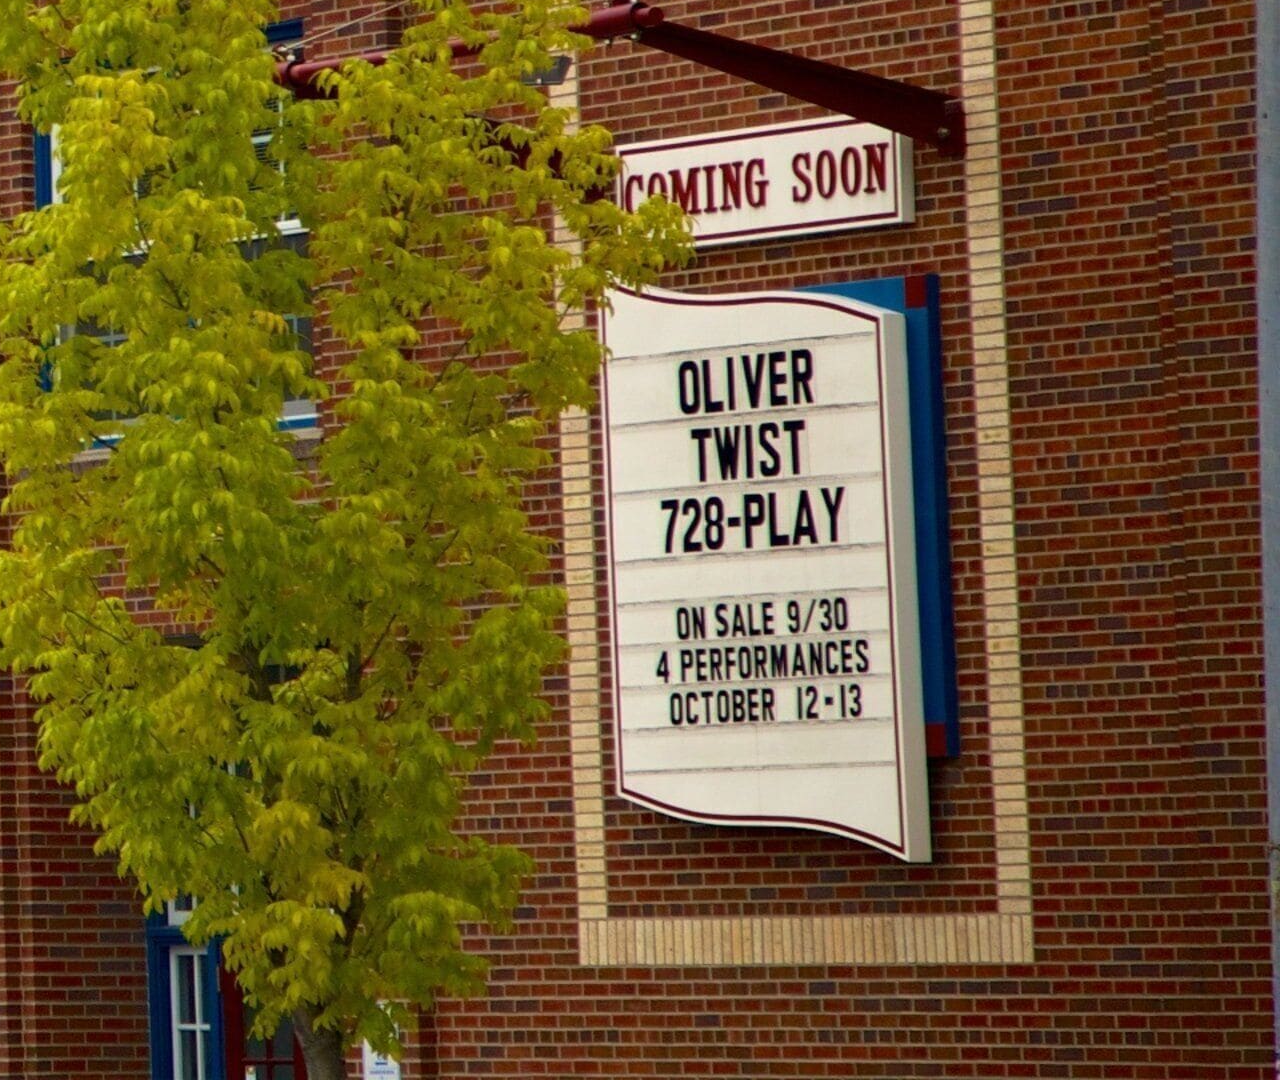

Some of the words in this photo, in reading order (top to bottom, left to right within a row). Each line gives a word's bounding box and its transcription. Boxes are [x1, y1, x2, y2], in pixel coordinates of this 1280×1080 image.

[791, 142, 890, 203] SOON
[678, 349, 814, 415] OLIVER
[690, 420, 806, 482] TWIST
[660, 486, 845, 553] 728-PLAY
[676, 606, 706, 640] ON
[715, 601, 775, 639] SALE
[787, 597, 848, 634] 9/30
[656, 651, 670, 683] 4
[680, 638, 870, 682] PERFORMANCES
[669, 688, 775, 725] OCTOBER
[797, 684, 862, 720] 12-13
